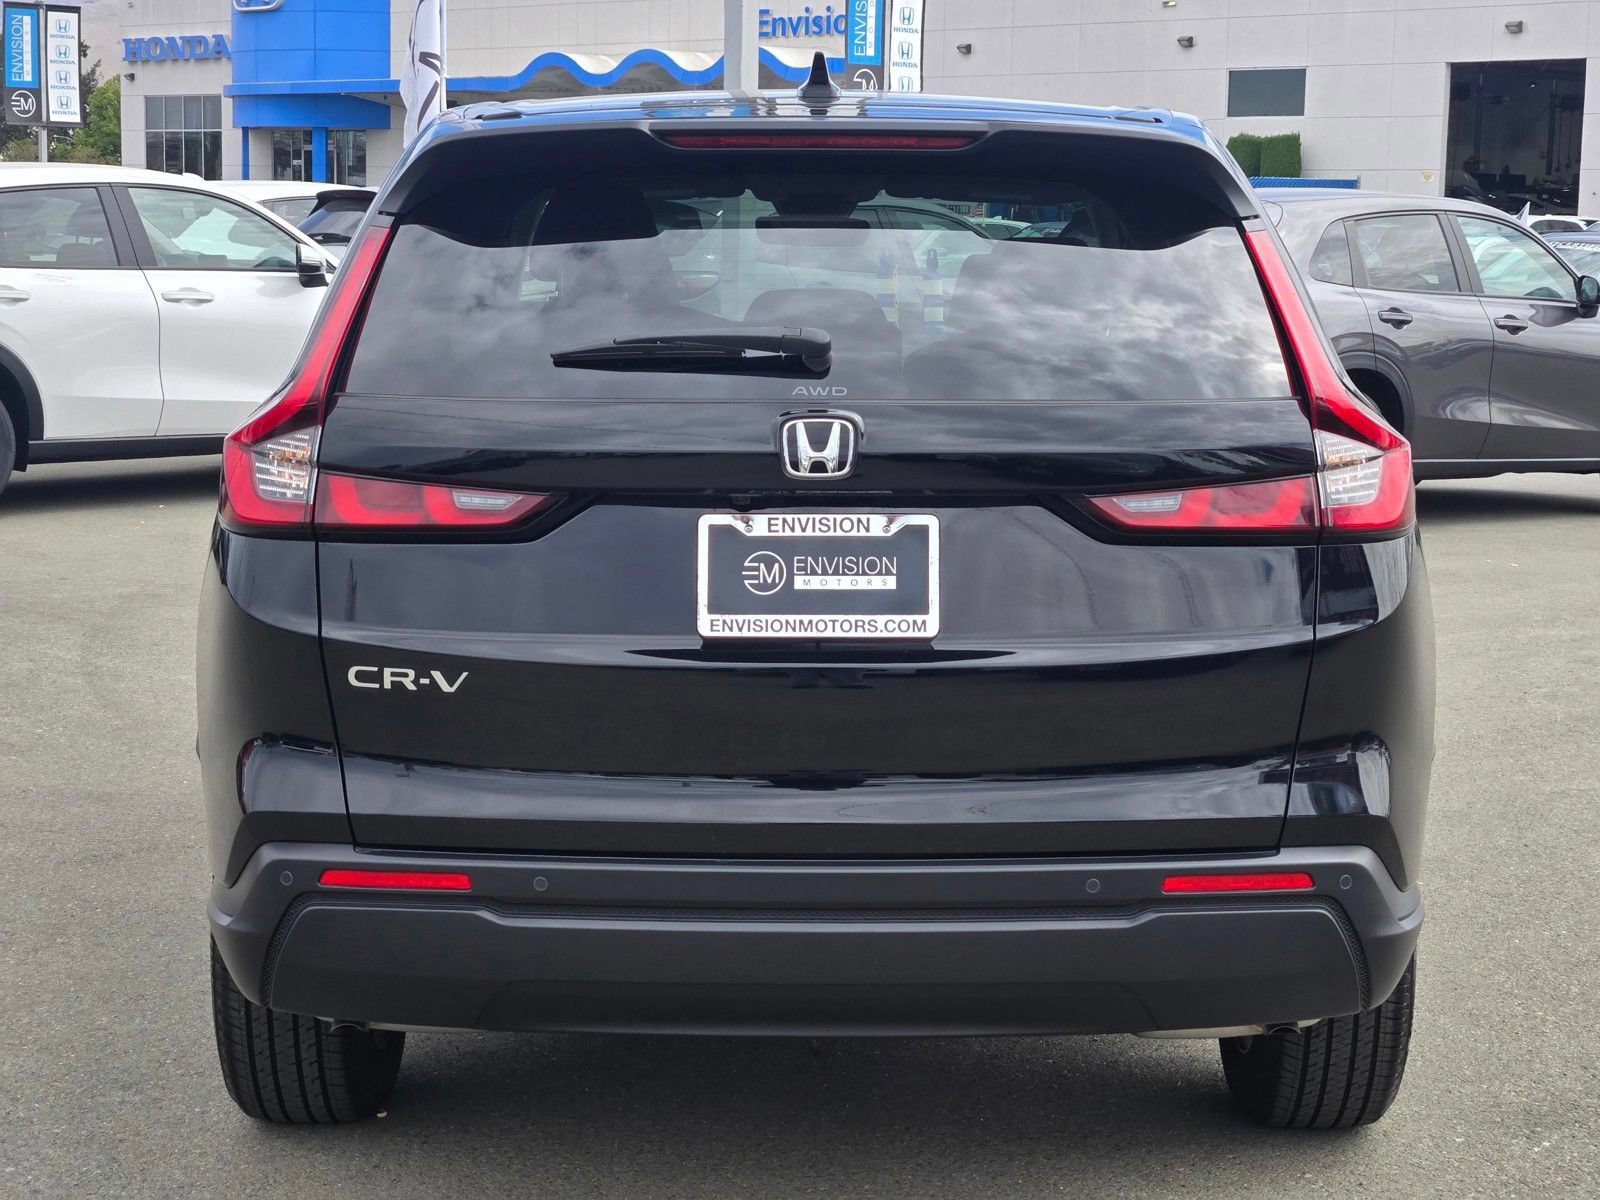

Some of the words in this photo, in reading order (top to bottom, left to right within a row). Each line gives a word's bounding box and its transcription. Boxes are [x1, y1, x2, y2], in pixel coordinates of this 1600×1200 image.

[12, 14, 23, 81] ENVISION
[122, 33, 232, 64] HONDA
[792, 386, 848, 396] AWD
[767, 516, 871, 534] ENVISION
[794, 556, 897, 575] ENVISION
[802, 578, 888, 587] MOTORS
[709, 618, 928, 633] ENVISIONMOTORS.COM
[347, 665, 469, 693] CR-V
